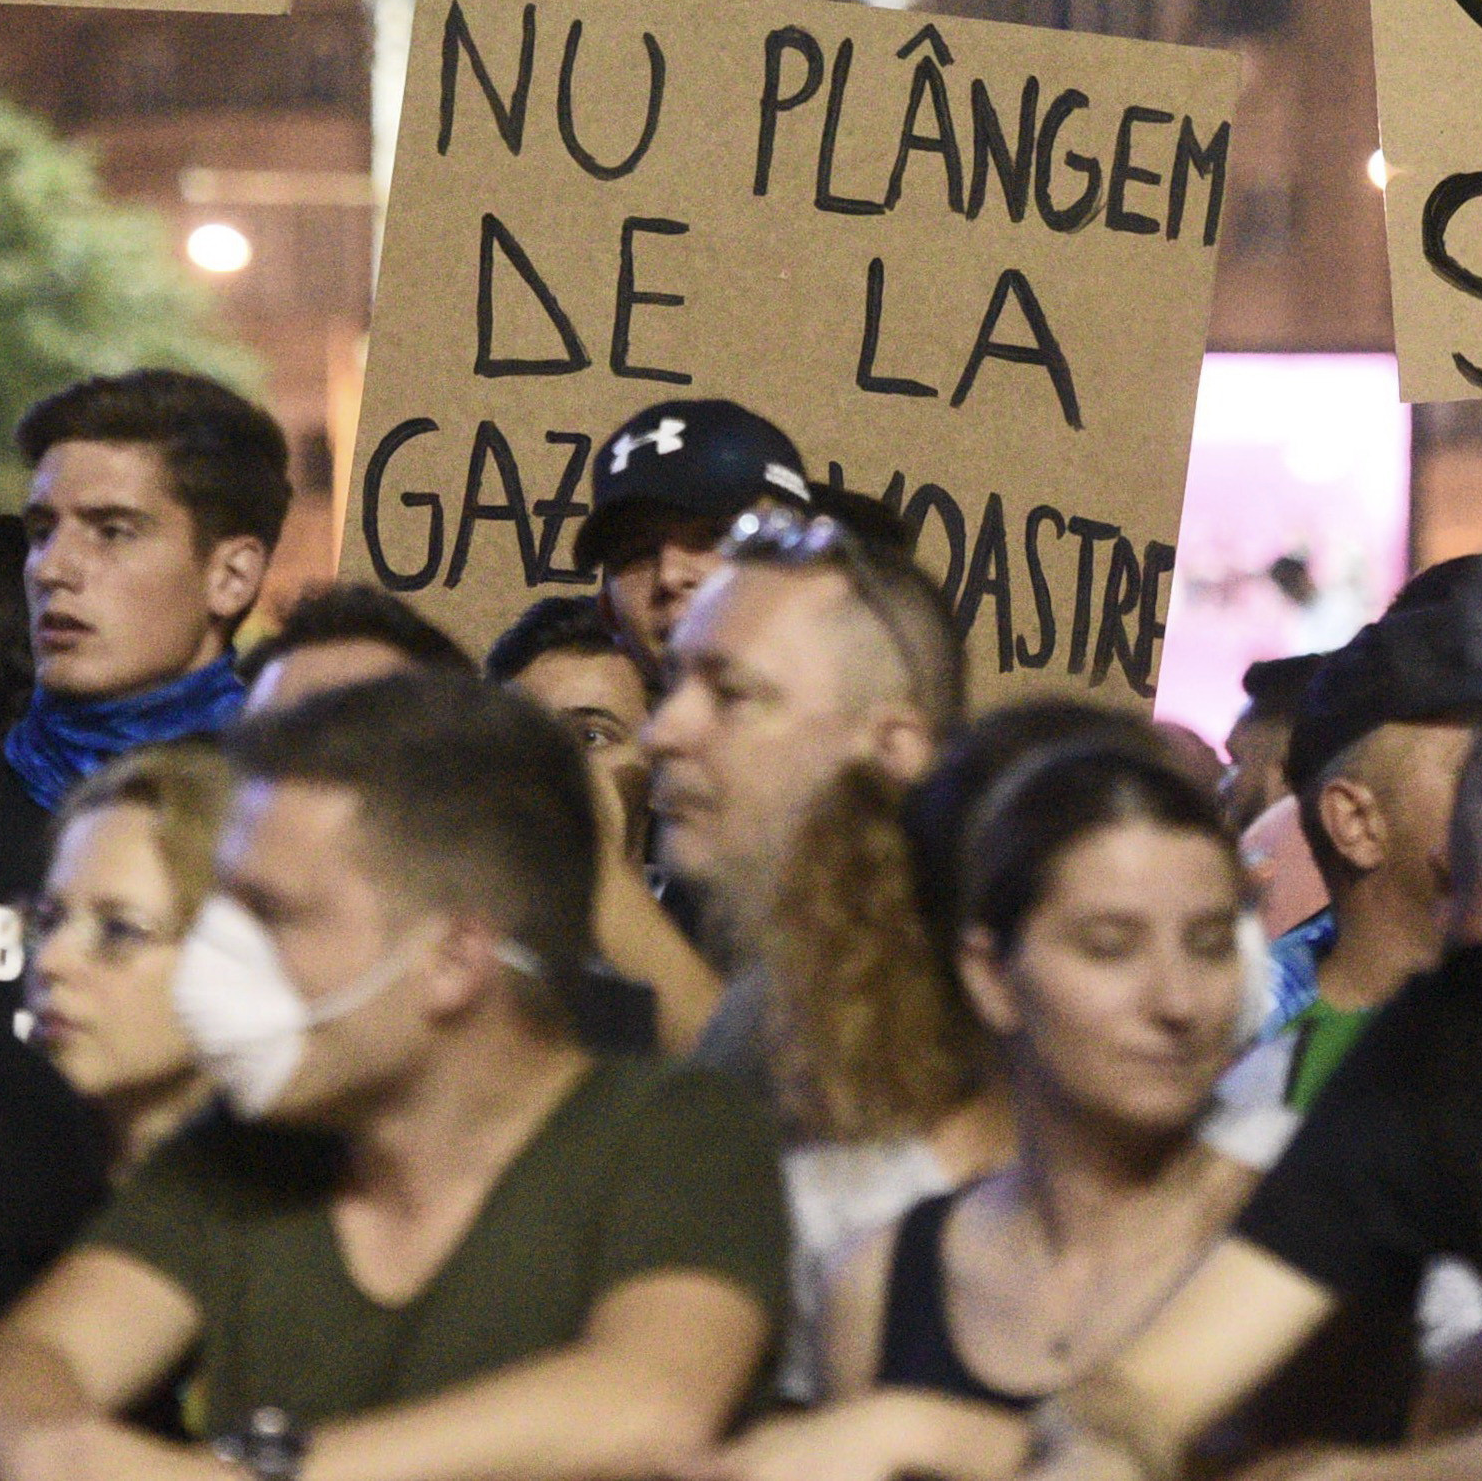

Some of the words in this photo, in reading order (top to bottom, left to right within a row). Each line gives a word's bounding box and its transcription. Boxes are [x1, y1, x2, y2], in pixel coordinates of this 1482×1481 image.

[437, 0, 666, 181] NU
[753, 23, 1231, 246] PLÂNGEM
[473, 213, 692, 385] DE
[856, 257, 1083, 430] LA
